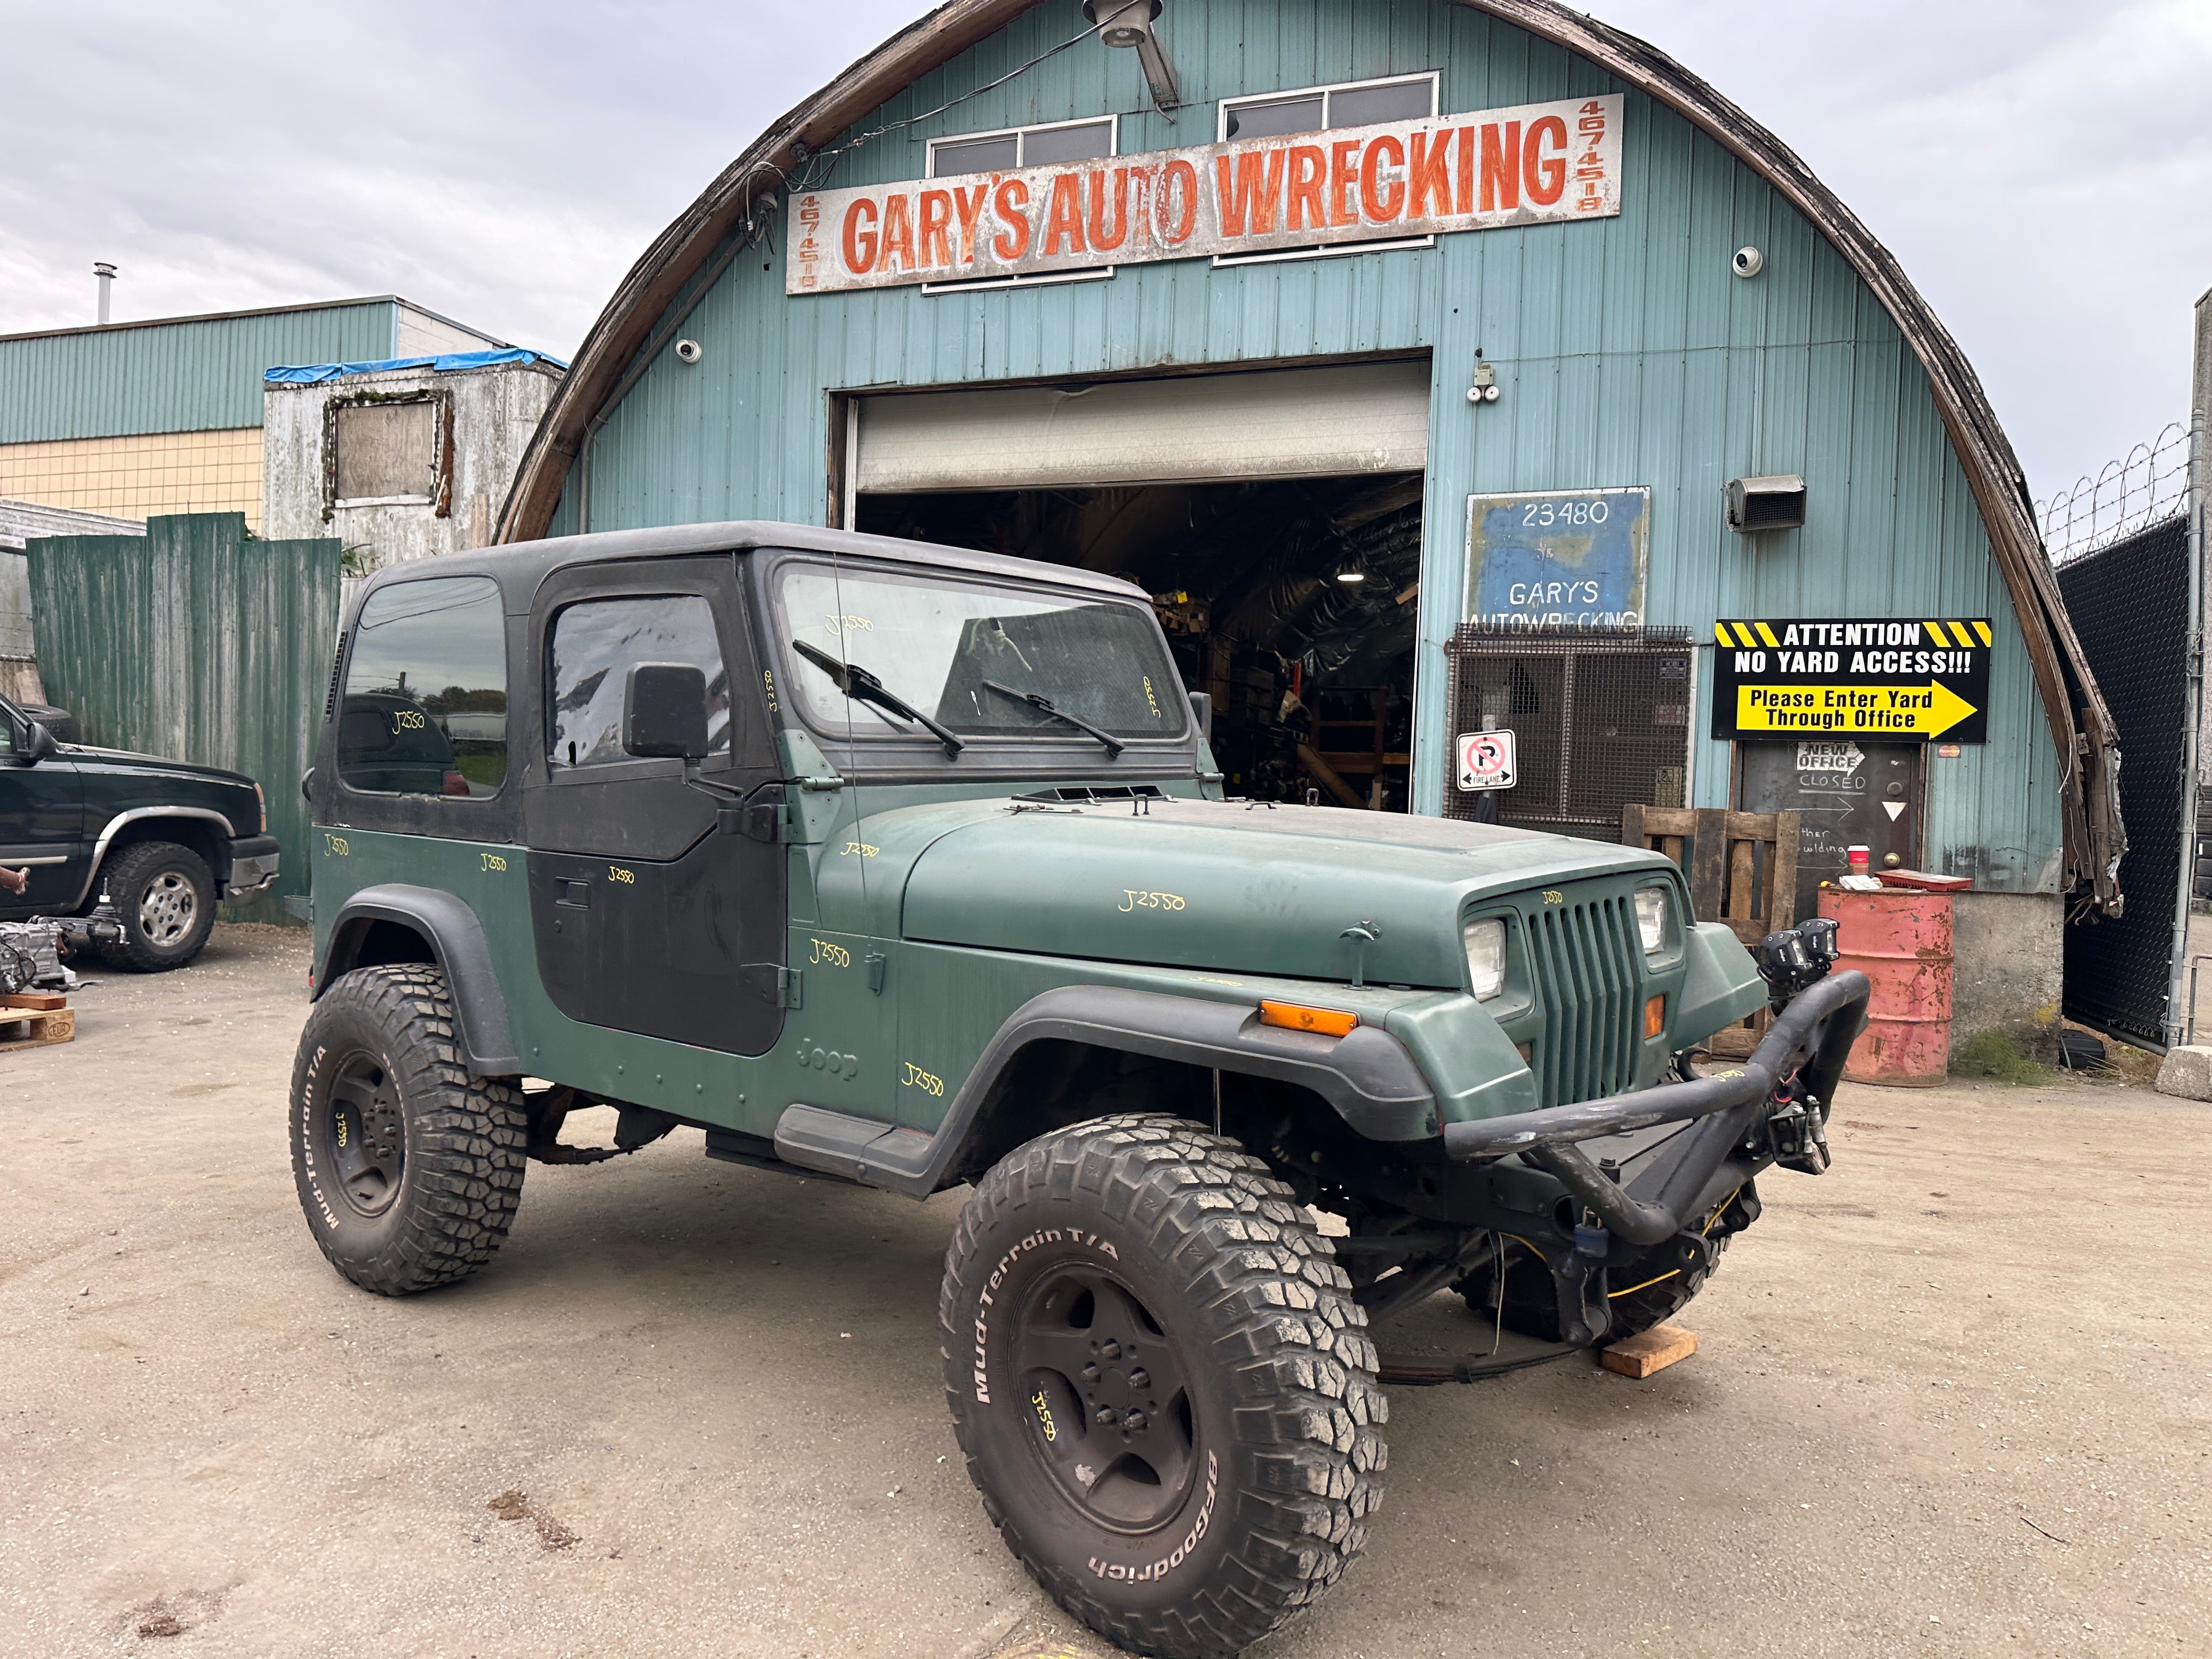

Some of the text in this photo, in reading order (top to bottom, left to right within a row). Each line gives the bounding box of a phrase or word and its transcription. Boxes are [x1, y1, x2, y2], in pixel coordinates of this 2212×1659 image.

[842, 115, 1568, 274] GARY'S AUTO WRECKING
[1522, 501, 1609, 527] 23480
[1510, 581, 1598, 605] GARY'S
[825, 615, 874, 635] J2550
[1783, 623, 1920, 646] ATTENTION
[1734, 652, 1971, 673] NO YARD ACCESS!!!
[764, 670, 777, 712] J2550
[1143, 676, 1161, 718] J2550
[1751, 690, 1932, 709] Please Enter Yard
[392, 711, 425, 734] J2550
[1766, 710, 1915, 729] Through Office
[1808, 744, 1847, 755] NEW
[1800, 774, 1866, 789] CLOSED
[324, 834, 349, 857] J2550
[840, 842, 880, 857] J2550
[1797, 841, 1847, 861] uilding
[480, 853, 506, 871] J2550
[608, 866, 634, 884] J2550
[1118, 889, 1185, 912] J2550
[809, 938, 850, 968] J2550
[901, 1062, 944, 1097] J2550
[302, 1045, 340, 1230] Mud-Terrain T/A
[335, 1112, 347, 1147] J2550
[975, 1227, 1119, 1404] Mud-Terrain T/A
[1032, 1391, 1056, 1442] J2550
[1088, 1450, 1218, 1584] BFGoodrich
